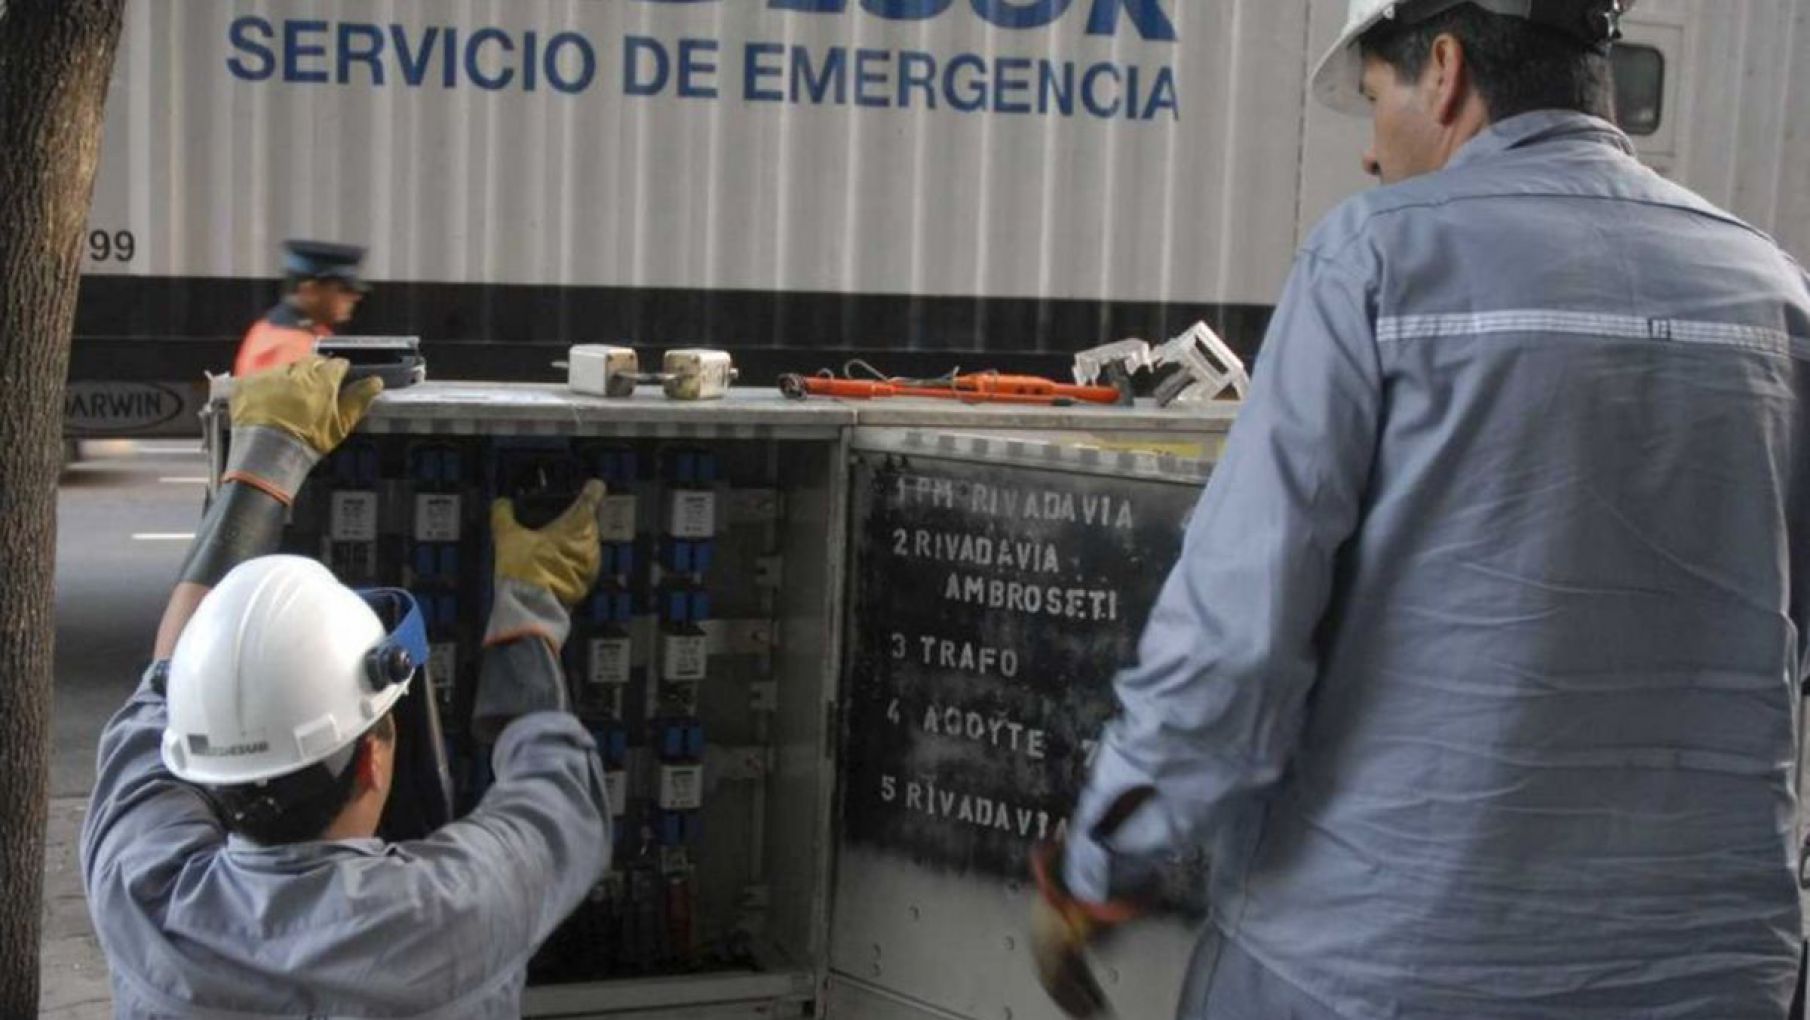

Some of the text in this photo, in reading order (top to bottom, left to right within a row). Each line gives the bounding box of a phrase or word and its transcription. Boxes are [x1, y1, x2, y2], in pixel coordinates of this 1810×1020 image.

[226, 14, 597, 95] SERVICIO
[622, 35, 719, 98] DE
[743, 42, 1180, 121] EMERGENCIA
[89, 229, 136, 262] 99
[971, 482, 1134, 529] RIVADAVIA
[892, 528, 1060, 573] 2 RIVADAVIA
[944, 572, 1118, 621] AMBROSETI
[891, 632, 1019, 678] 3 TRAFO
[886, 697, 900, 725] 4
[881, 773, 897, 801] 5
